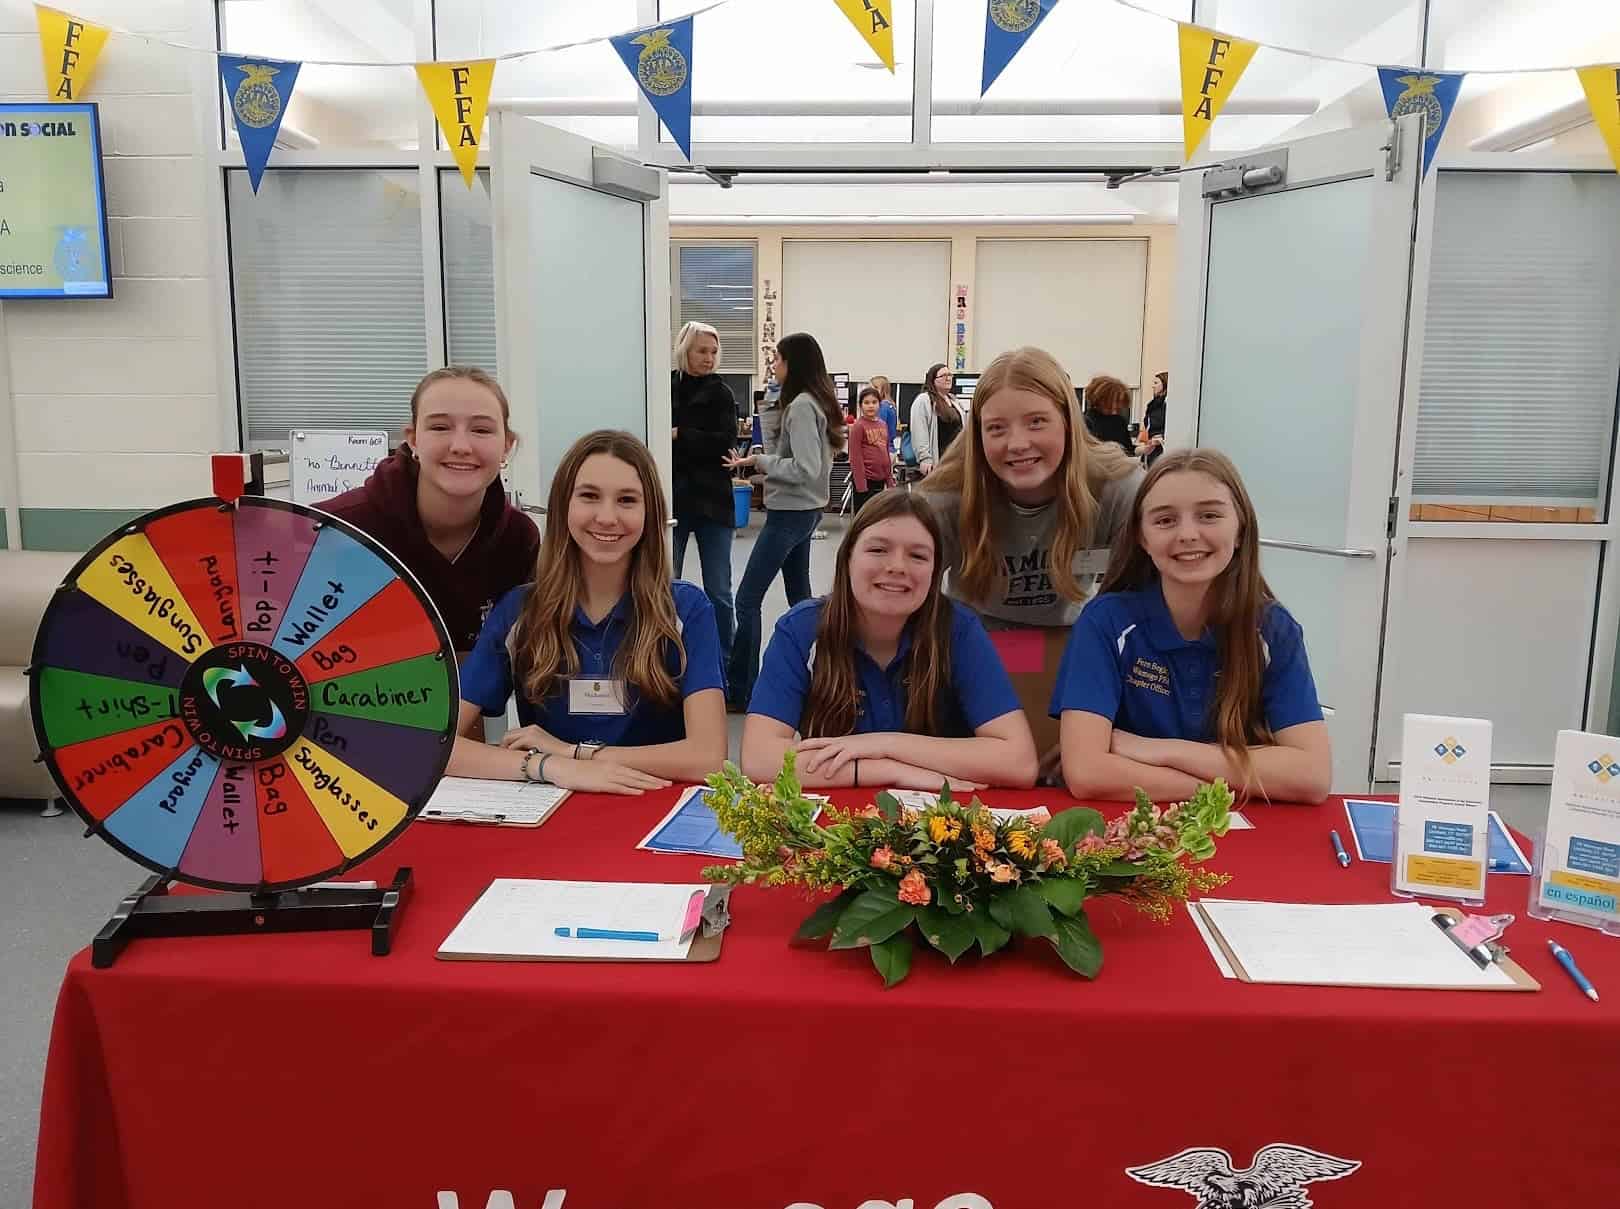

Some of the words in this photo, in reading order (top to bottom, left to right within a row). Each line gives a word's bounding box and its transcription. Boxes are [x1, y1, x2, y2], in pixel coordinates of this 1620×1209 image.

[56, 21, 84, 100] FFA
[1192, 38, 1230, 120] FFA
[21, 122, 76, 136] SOCIAL
[451, 67, 478, 146] FFA
[109, 553, 202, 655] Sunglasses
[200, 554, 238, 641] Lanyard
[282, 580, 345, 647] Wallet
[116, 640, 168, 679] Pen
[228, 646, 270, 661] SPIN
[273, 655, 292, 674] TO
[289, 676, 305, 710] WIN
[312, 644, 358, 672] Bag
[183, 697, 201, 731] WIN
[322, 681, 433, 708] Carabiner
[75, 724, 185, 792] Carabiner
[200, 732, 217, 752] TO
[221, 744, 262, 760] SPIN
[311, 716, 348, 751] Pen
[158, 749, 218, 814] Lanyard
[222, 765, 244, 834] Wallet
[259, 763, 287, 816] Bag
[294, 745, 379, 832] Sunglasses
[1547, 888, 1560, 898] en
[1566, 893, 1615, 909] español
